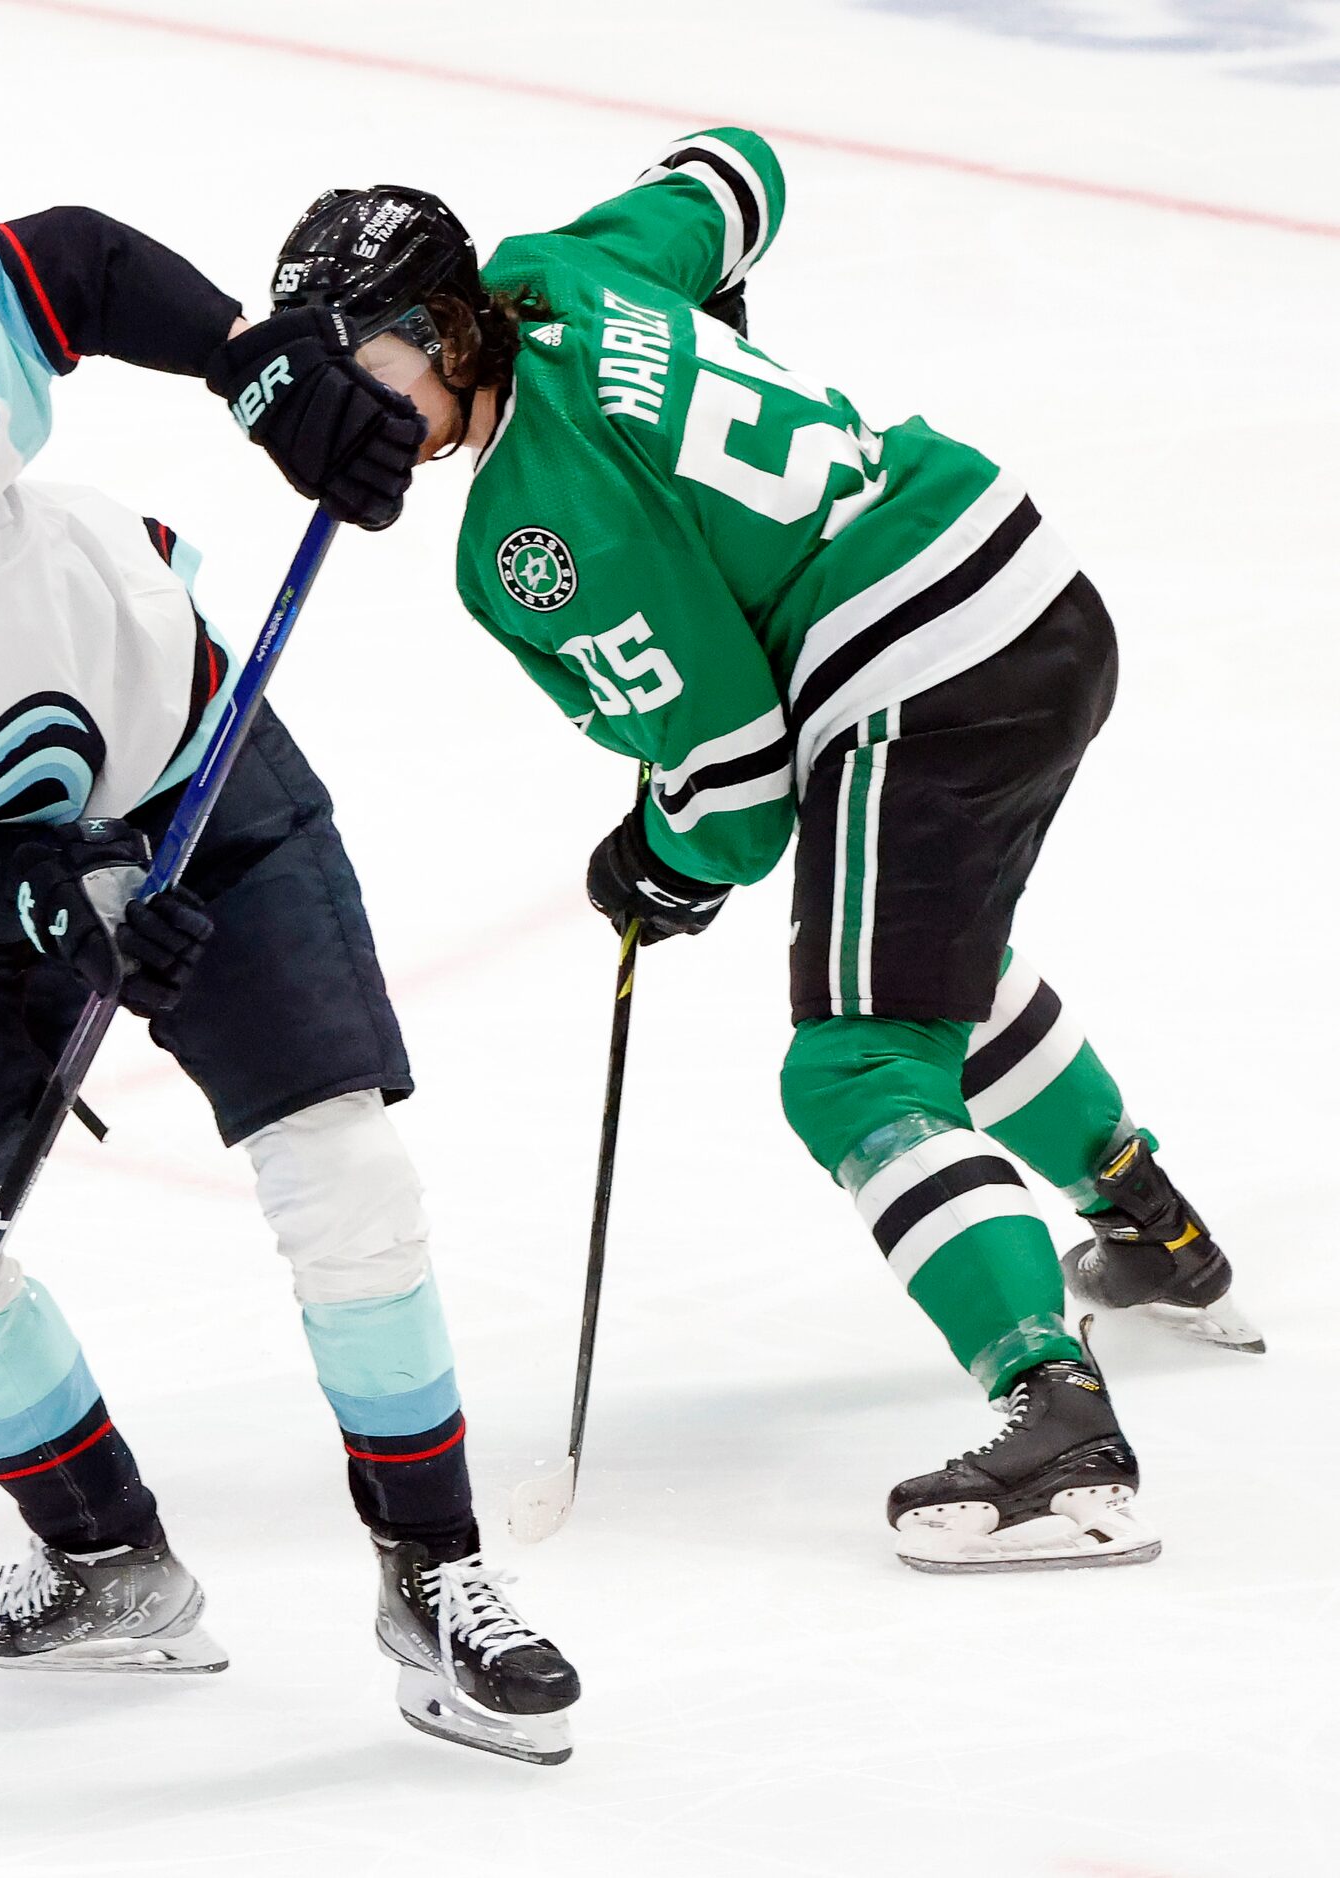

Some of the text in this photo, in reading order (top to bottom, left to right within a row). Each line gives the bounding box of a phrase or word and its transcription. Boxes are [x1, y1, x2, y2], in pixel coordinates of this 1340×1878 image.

[275, 263, 306, 292] 55
[598, 287, 671, 425] HARL
[502, 533, 559, 582] DALLAS
